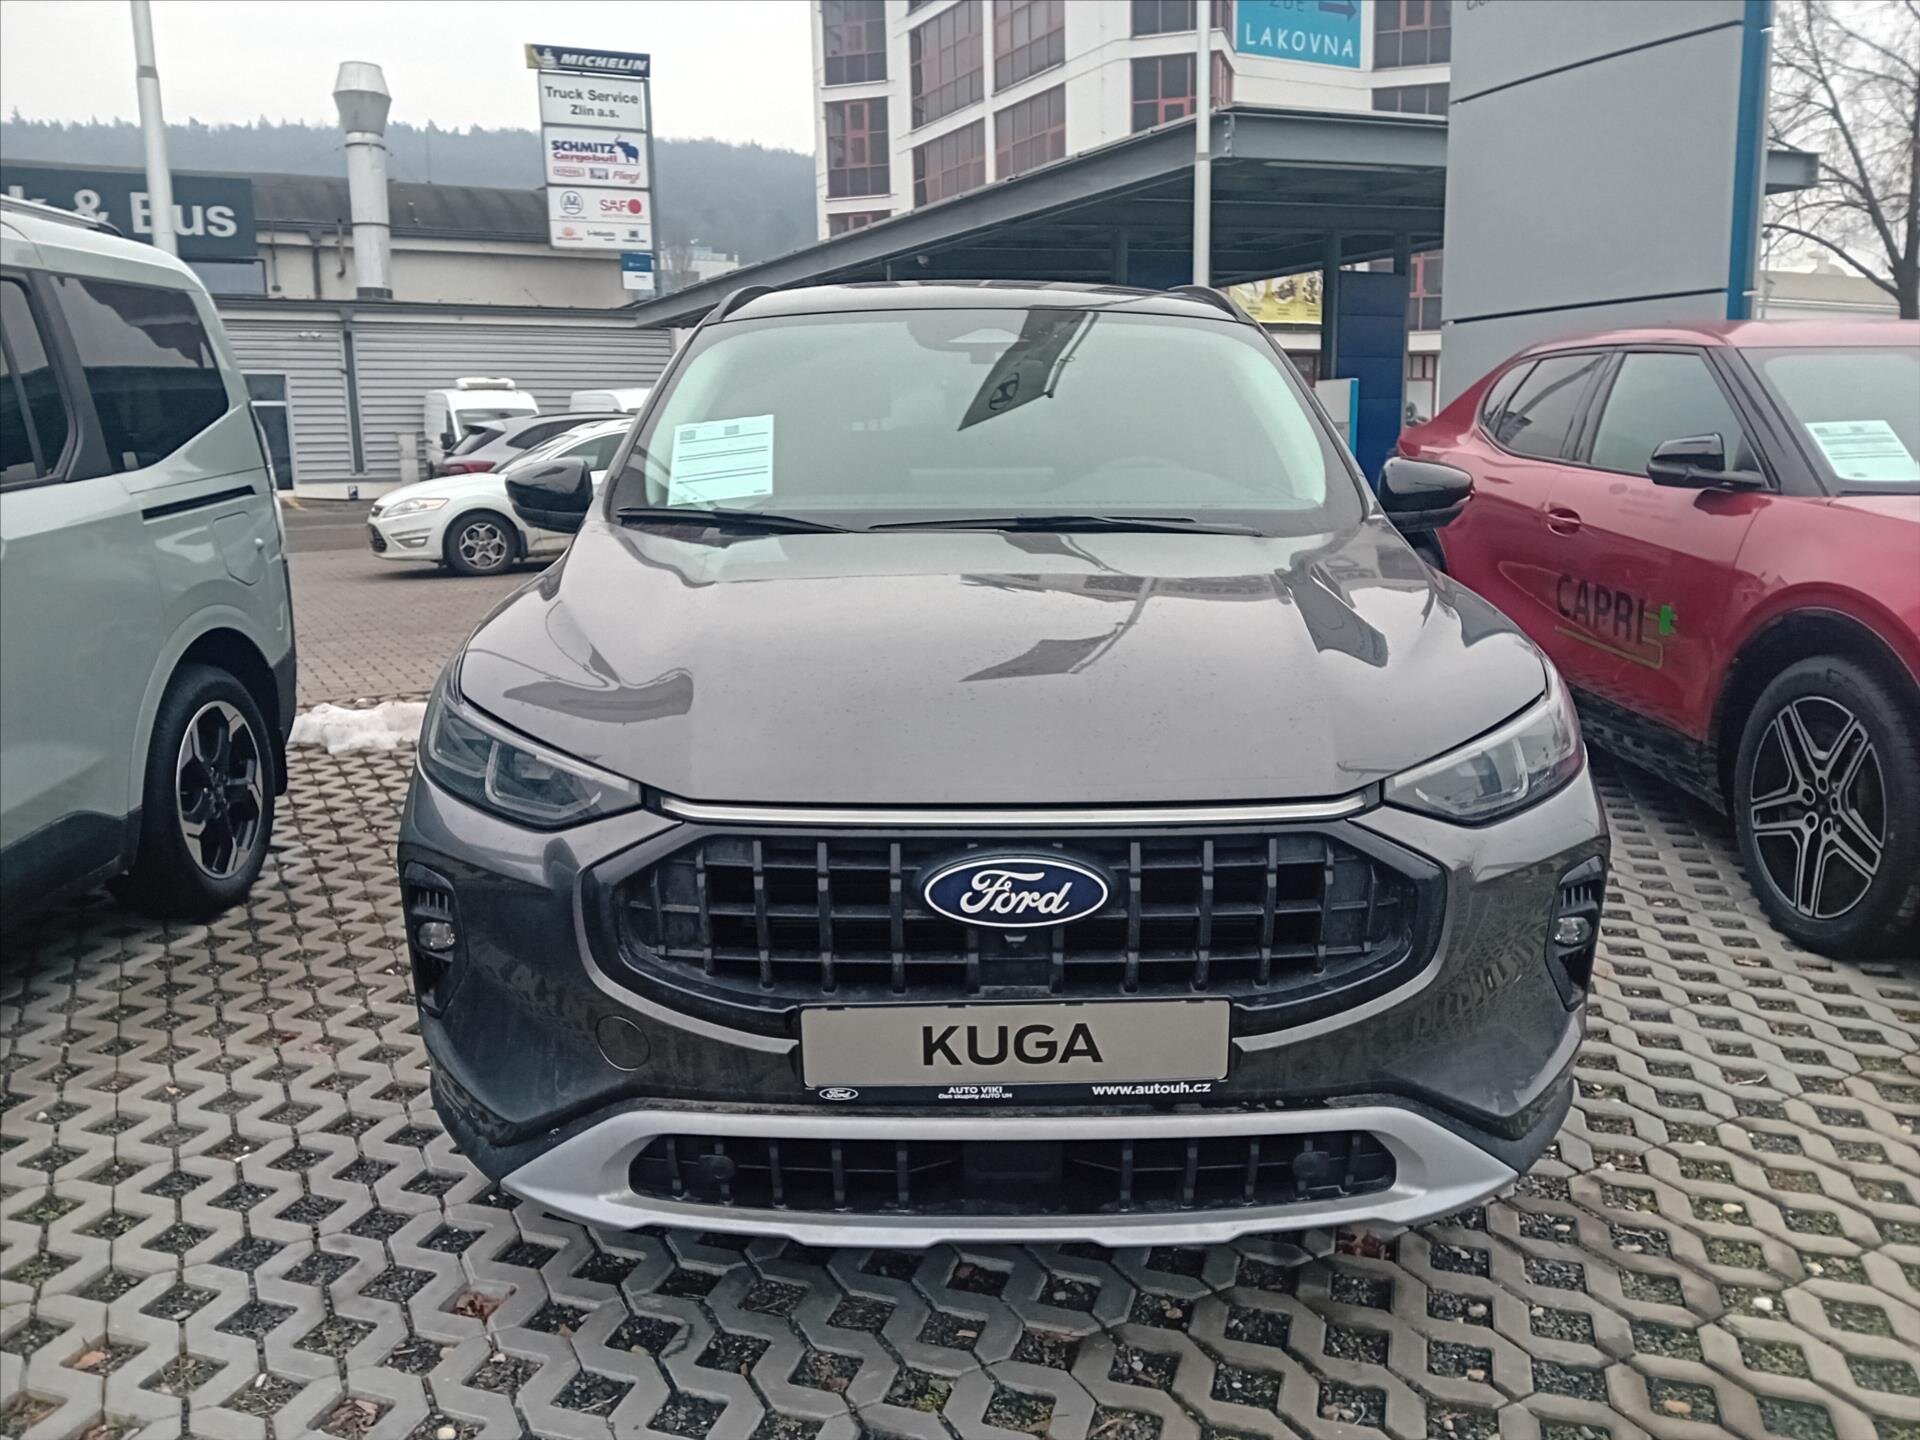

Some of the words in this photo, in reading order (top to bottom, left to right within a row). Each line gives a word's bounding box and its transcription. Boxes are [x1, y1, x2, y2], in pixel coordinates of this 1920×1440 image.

[1245, 23, 1354, 58] LAKOVNA
[560, 53, 648, 71] MICHELIN
[544, 85, 583, 101] Truck
[587, 89, 639, 105] Service
[597, 108, 620, 119] a.s.
[551, 140, 616, 154] SCHMITZ
[1556, 573, 1645, 645] CAPRI
[960, 869, 1073, 914] Ford
[922, 1023, 1103, 1066] KUGA
[948, 1086, 979, 1094] AUTO
[1092, 1082, 1211, 1095] www.autouh.cz
